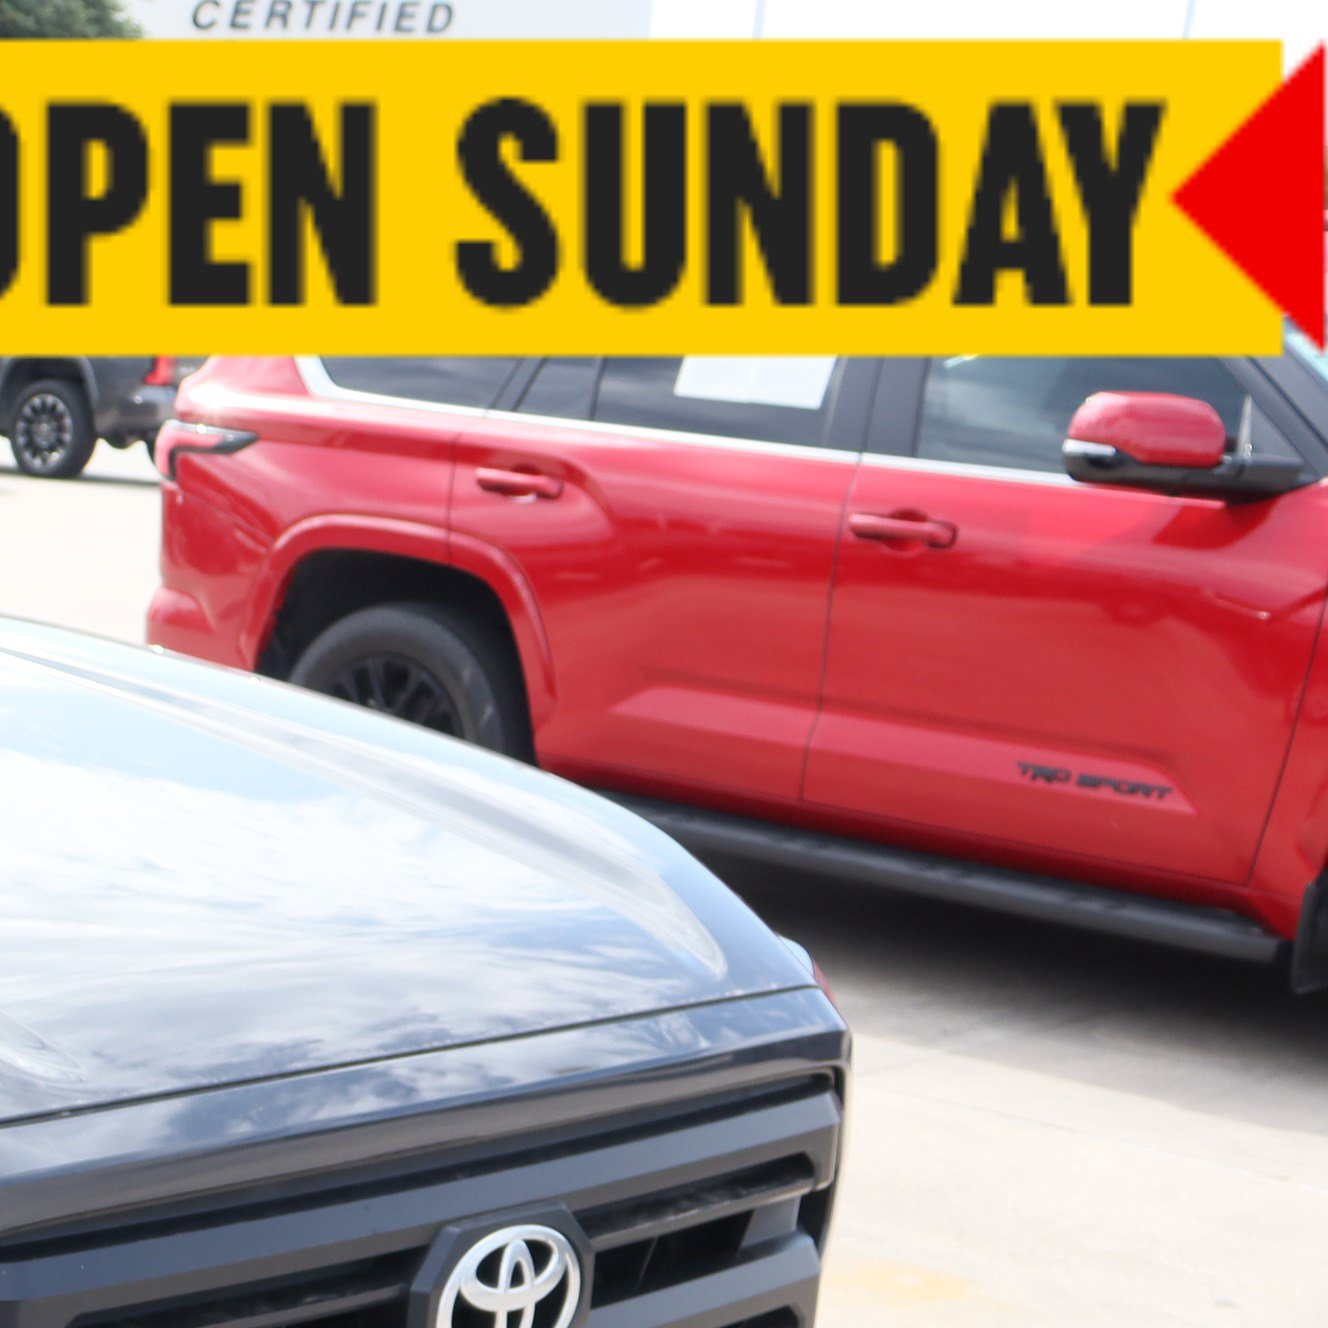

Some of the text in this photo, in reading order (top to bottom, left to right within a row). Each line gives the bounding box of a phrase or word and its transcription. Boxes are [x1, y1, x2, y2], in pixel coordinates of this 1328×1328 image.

[193, 0, 454, 33] CERTIFIED
[1017, 762, 1173, 799] TRD SPORT
